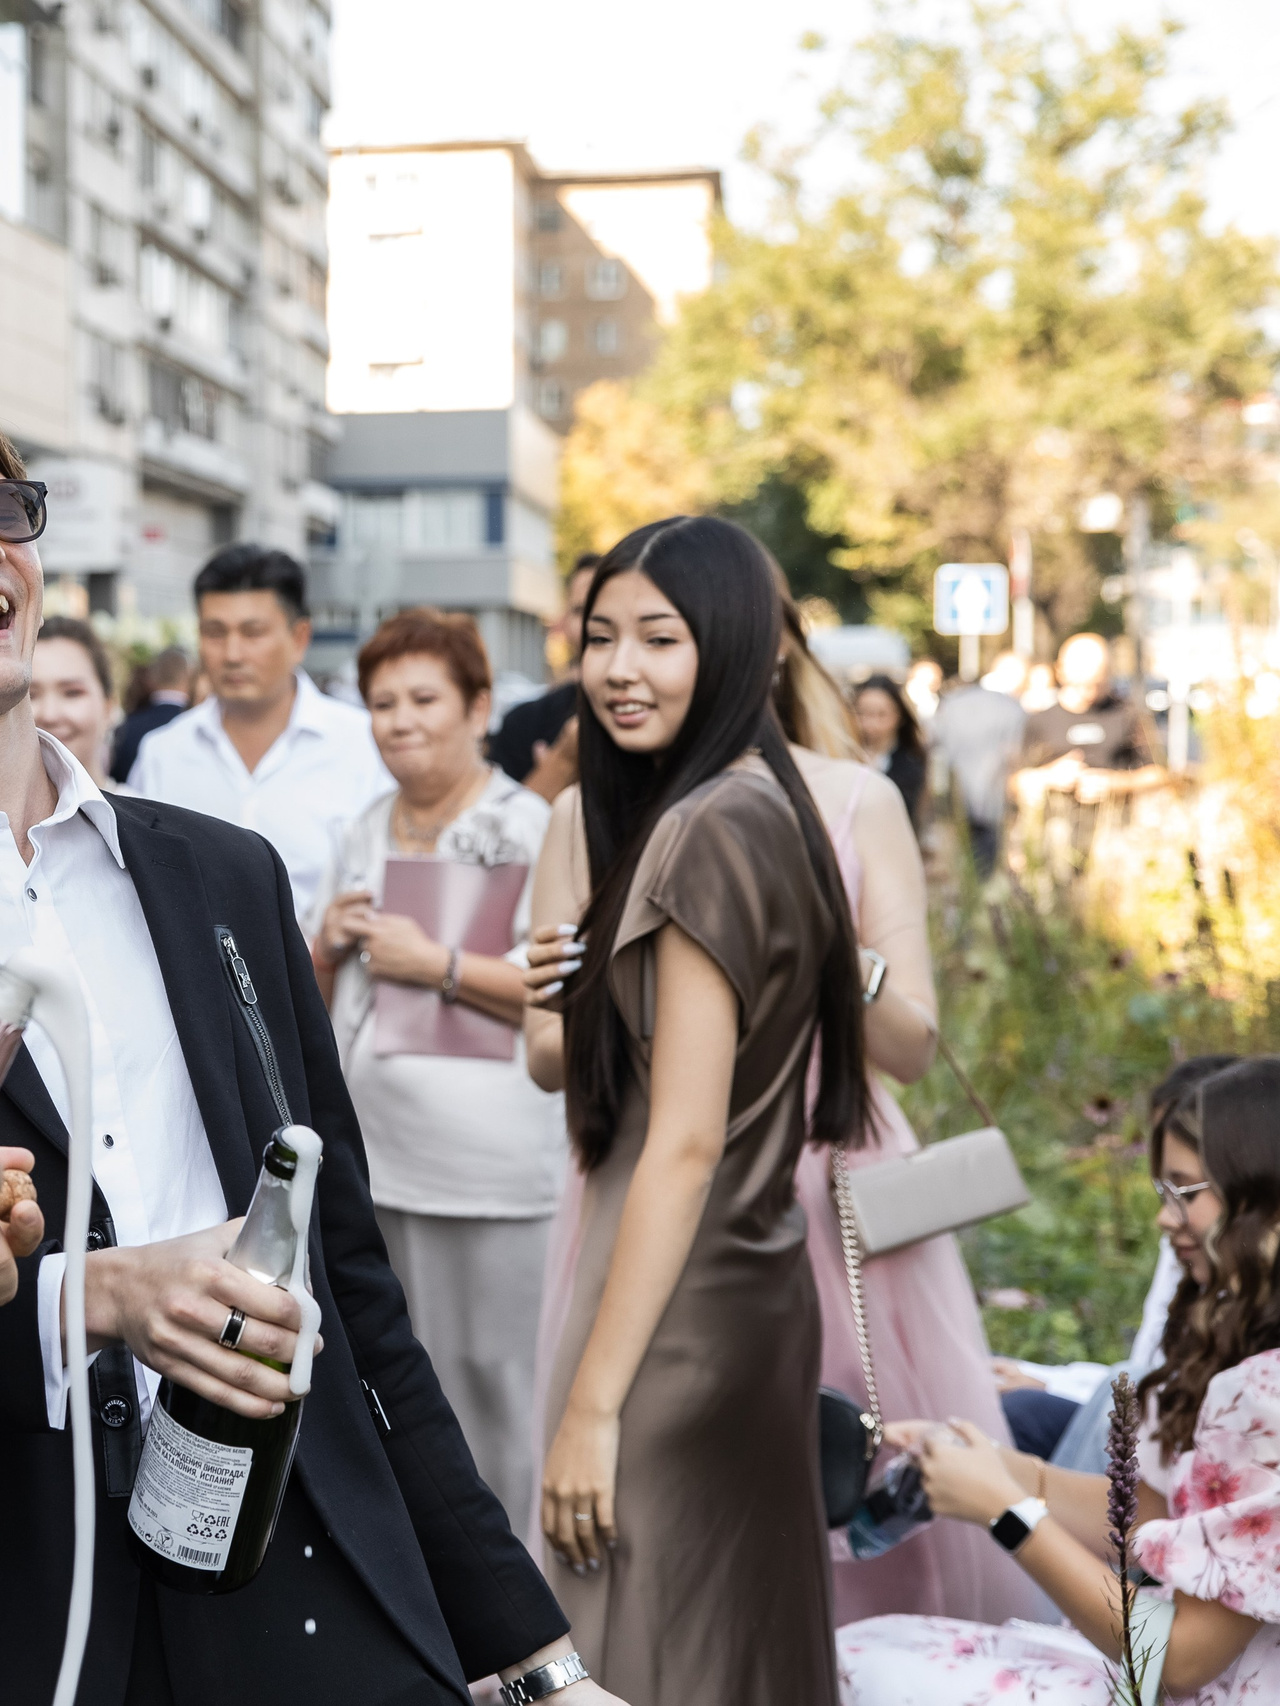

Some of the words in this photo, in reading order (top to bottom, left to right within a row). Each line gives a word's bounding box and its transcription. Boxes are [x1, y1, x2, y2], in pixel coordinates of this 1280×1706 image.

[105, 1399, 126, 1410] PHILIPP
[156, 1431, 202, 1469] ПРОИСХОЖДЕНИЯ
[211, 1443, 232, 1453] СЛАДКОЕ
[161, 1448, 197, 1478] КАТАЛОНИЯ,
[199, 1470, 235, 1486] ИСПАНИЯ
[154, 1542, 171, 1555] VEGAN
